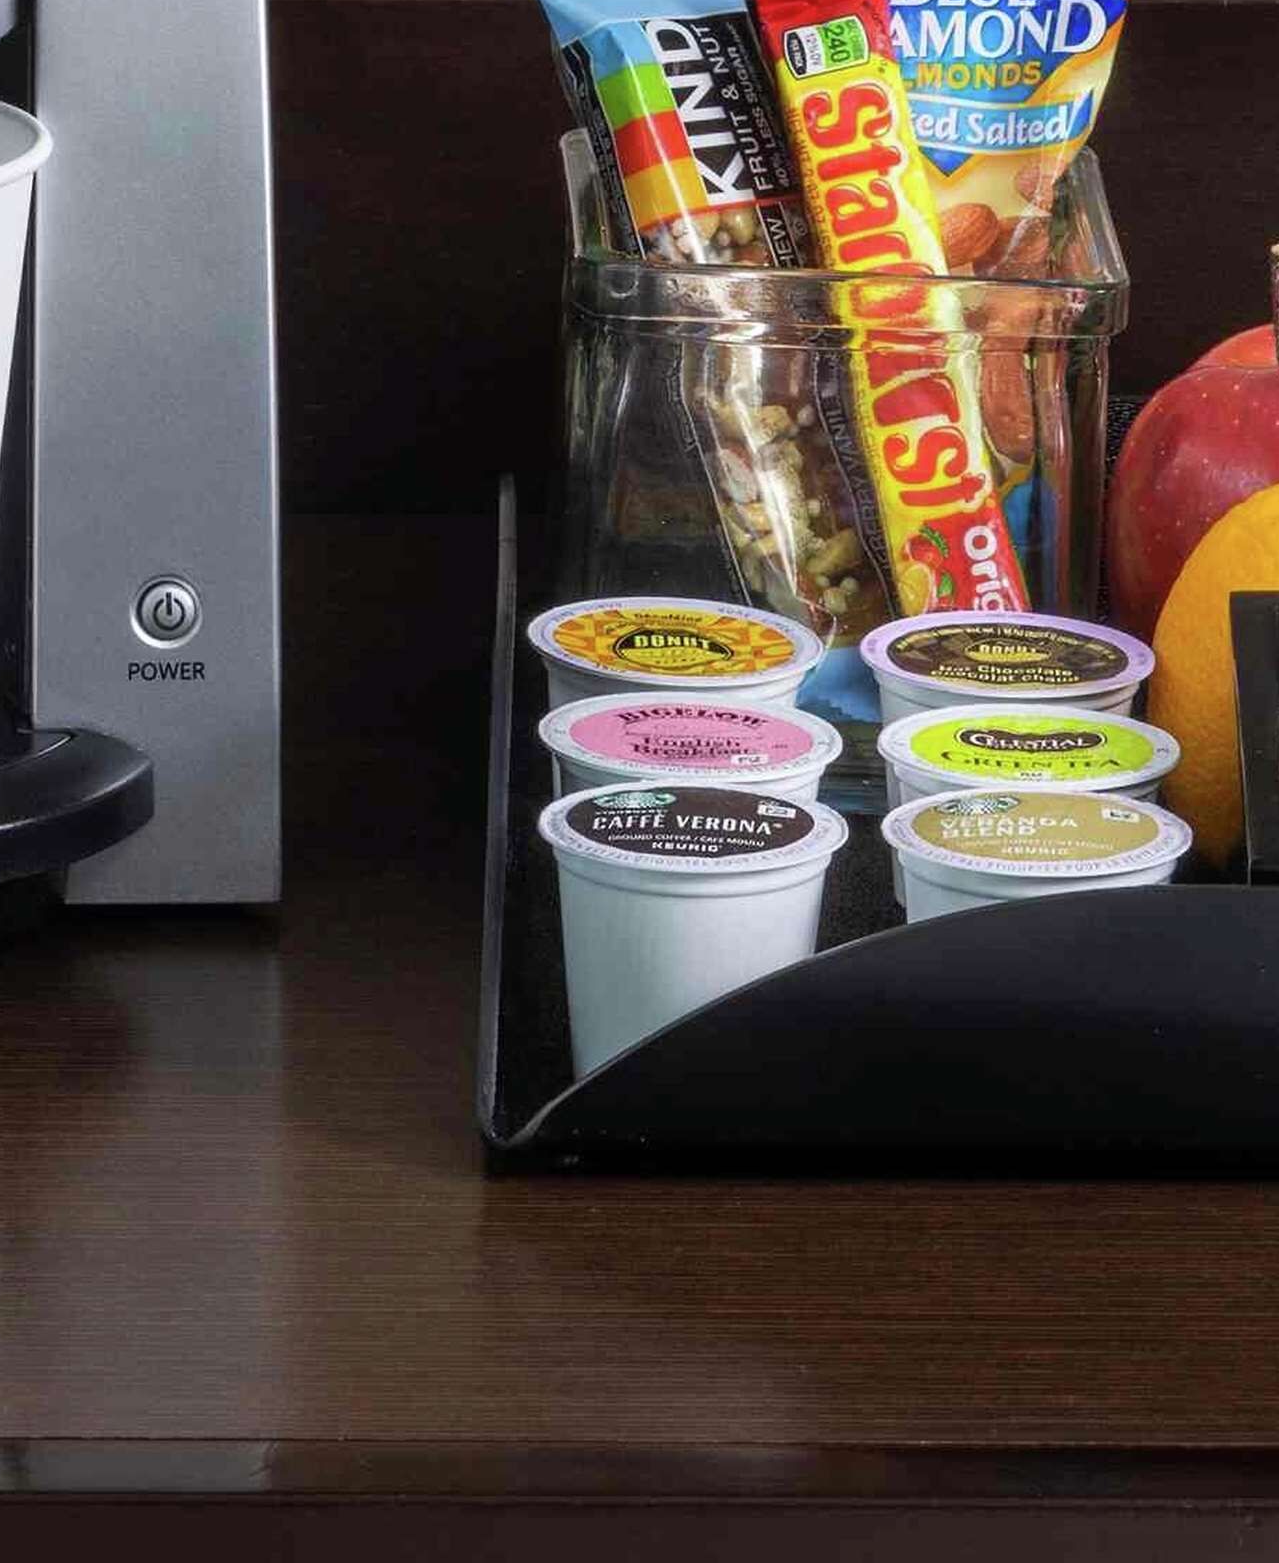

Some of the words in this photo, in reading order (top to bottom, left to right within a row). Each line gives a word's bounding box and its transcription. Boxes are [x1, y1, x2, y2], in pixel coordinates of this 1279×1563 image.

[691, 22, 731, 75] NUT
[822, 24, 851, 63] 240
[721, 83, 740, 101] &
[901, 61, 1043, 90] MONDS
[645, 18, 754, 206] KIND
[751, 106, 776, 149] LESS
[966, 104, 1072, 147] Salted
[729, 110, 773, 192] FRUIT
[765, 217, 794, 268] HEW
[961, 527, 1007, 612] Orig
[634, 634, 711, 650] DONUT
[127, 661, 206, 681] POWER
[617, 705, 768, 729] BIGELOW
[591, 811, 667, 831] CAFFÈ
[675, 814, 773, 836] VERONA
[651, 842, 721, 854] KEURIG
